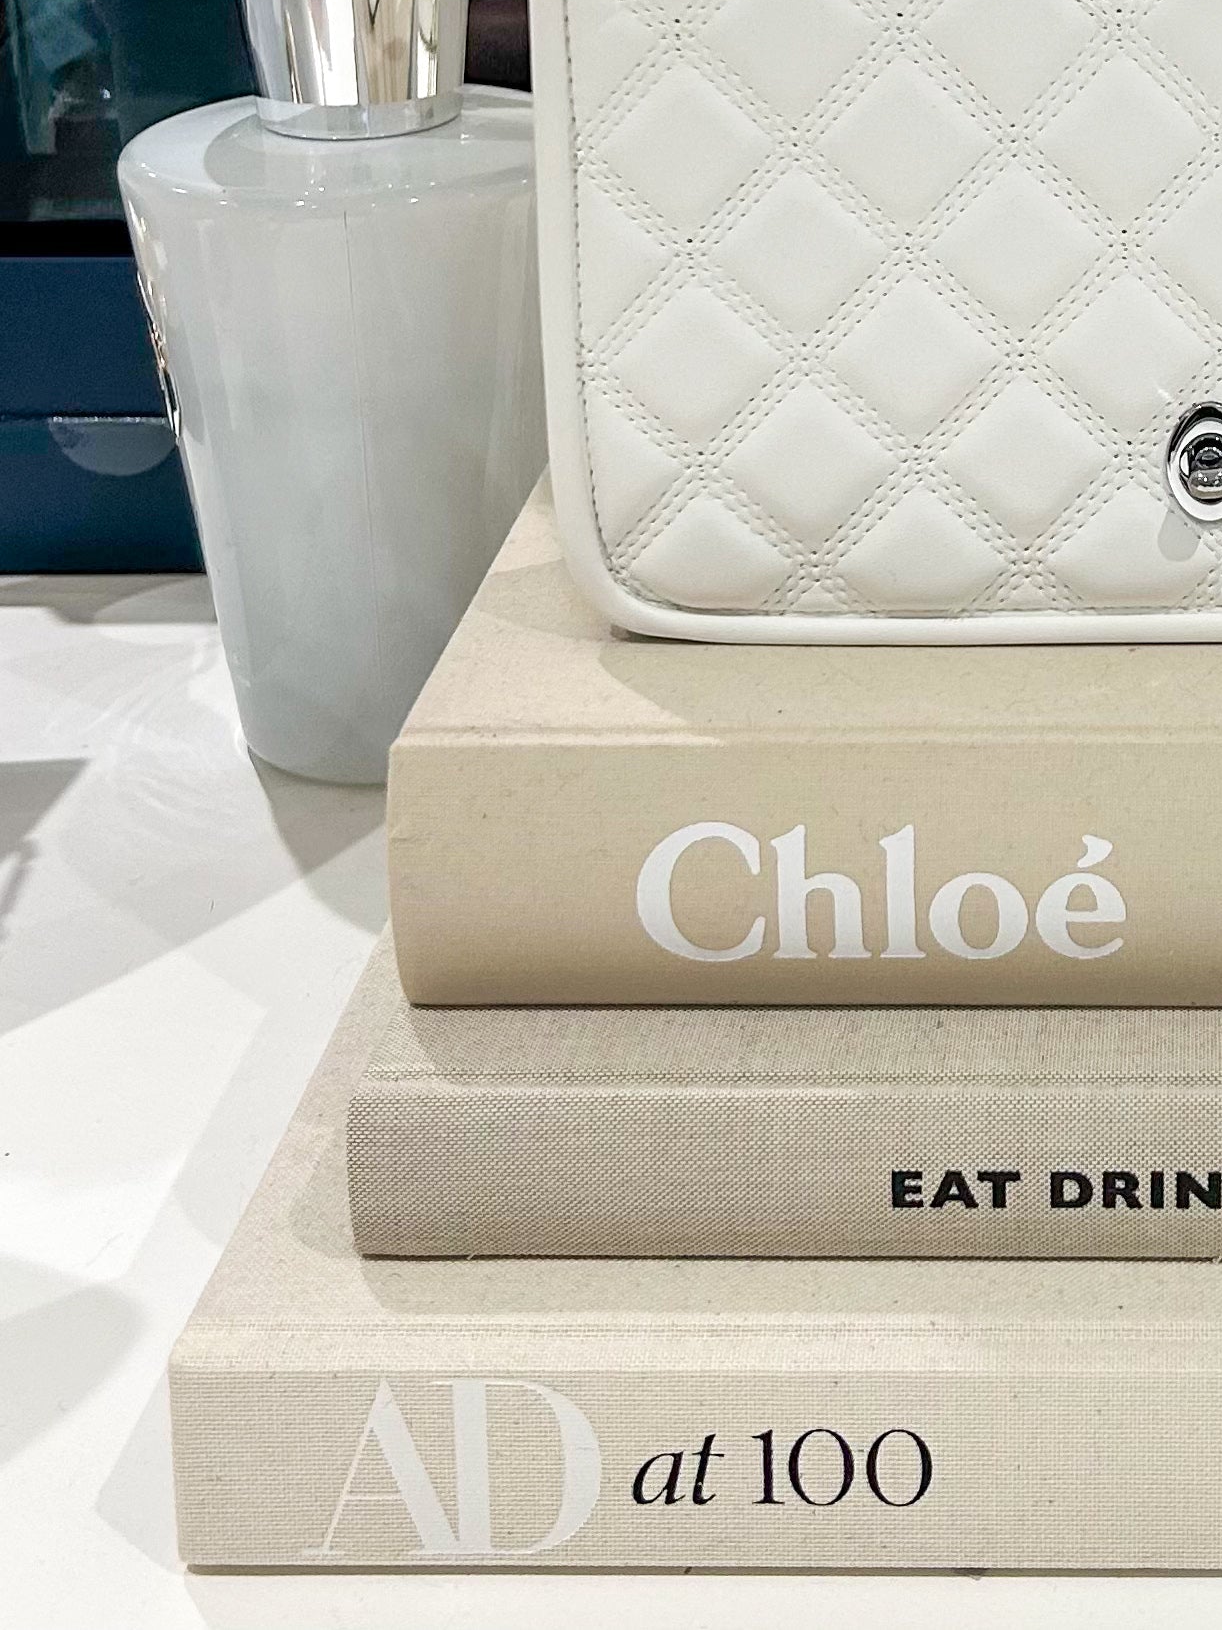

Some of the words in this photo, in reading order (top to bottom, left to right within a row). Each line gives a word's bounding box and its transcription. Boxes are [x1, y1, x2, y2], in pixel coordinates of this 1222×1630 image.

[636, 821, 1128, 962] Chloé
[890, 1169, 1021, 1210] EAT
[301, 1377, 602, 1556] AD
[632, 1433, 725, 1507] at
[751, 1428, 934, 1507] 100
